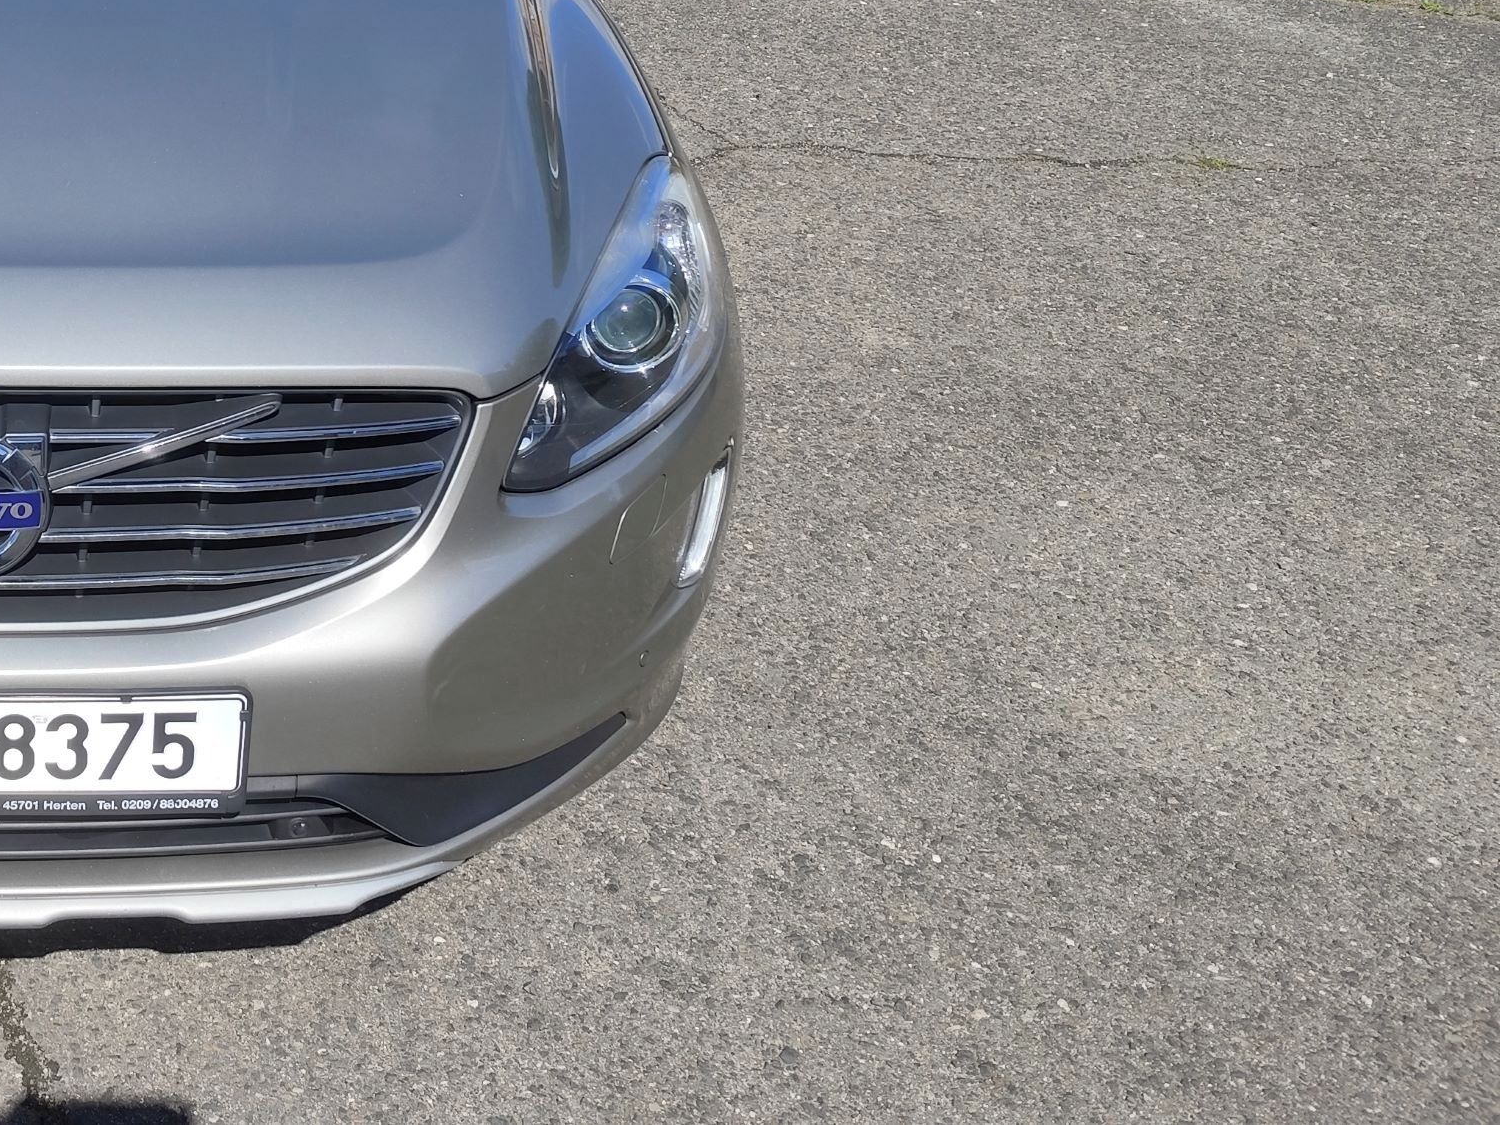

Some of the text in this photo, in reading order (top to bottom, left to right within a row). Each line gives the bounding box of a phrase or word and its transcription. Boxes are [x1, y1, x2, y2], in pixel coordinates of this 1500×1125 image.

[2, 800, 40, 811] 45701
[43, 800, 87, 811] Herten
[97, 799, 119, 811] Tel.
